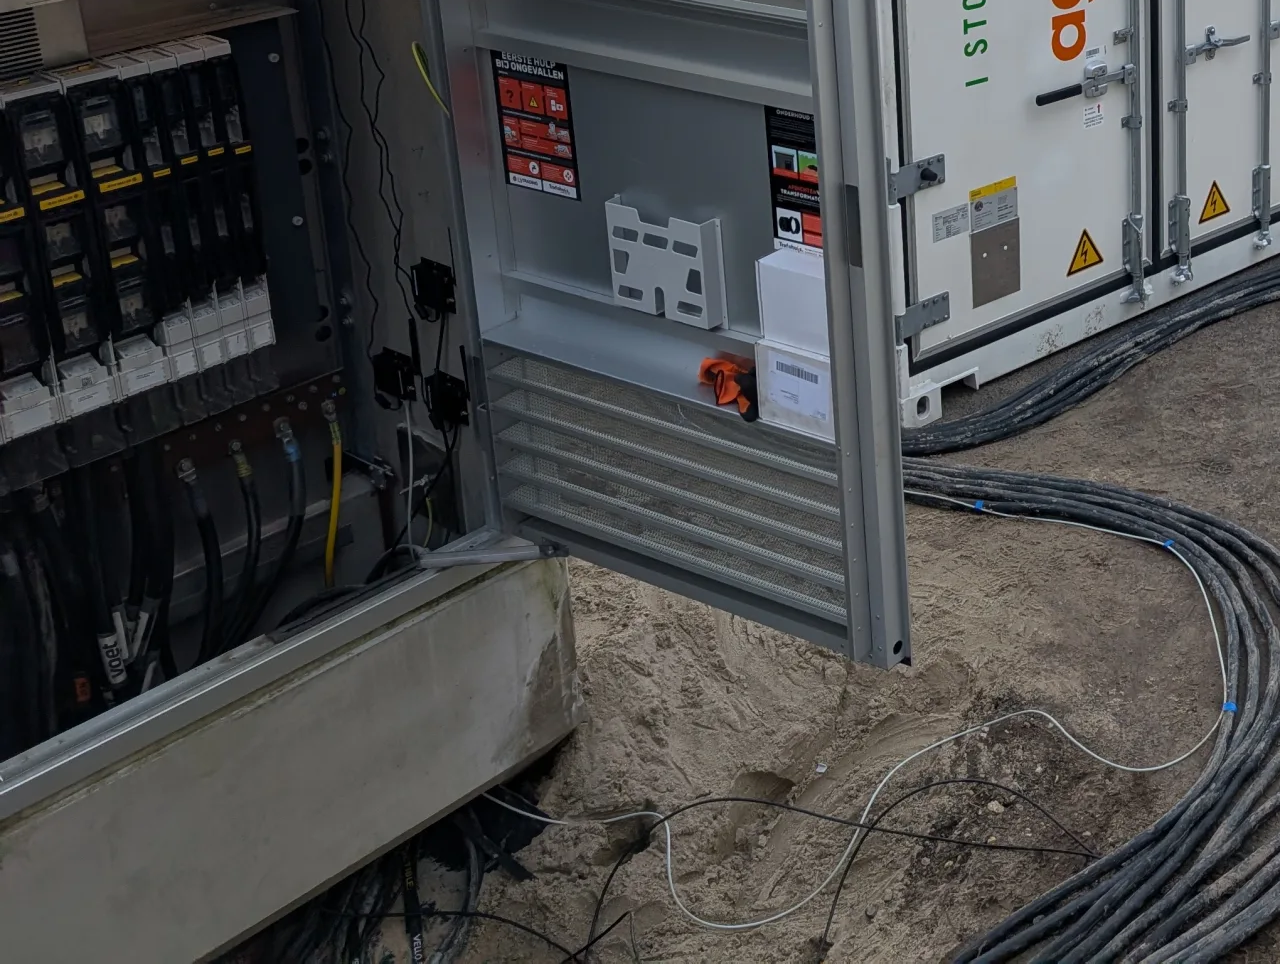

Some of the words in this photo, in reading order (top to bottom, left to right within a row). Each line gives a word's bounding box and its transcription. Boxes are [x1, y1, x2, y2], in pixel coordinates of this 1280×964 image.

[495, 58, 510, 70] BIJ
[510, 62, 564, 81] ONGEVALLEN
[501, 51, 533, 65] EERSTE
[533, 57, 556, 70] HULP
